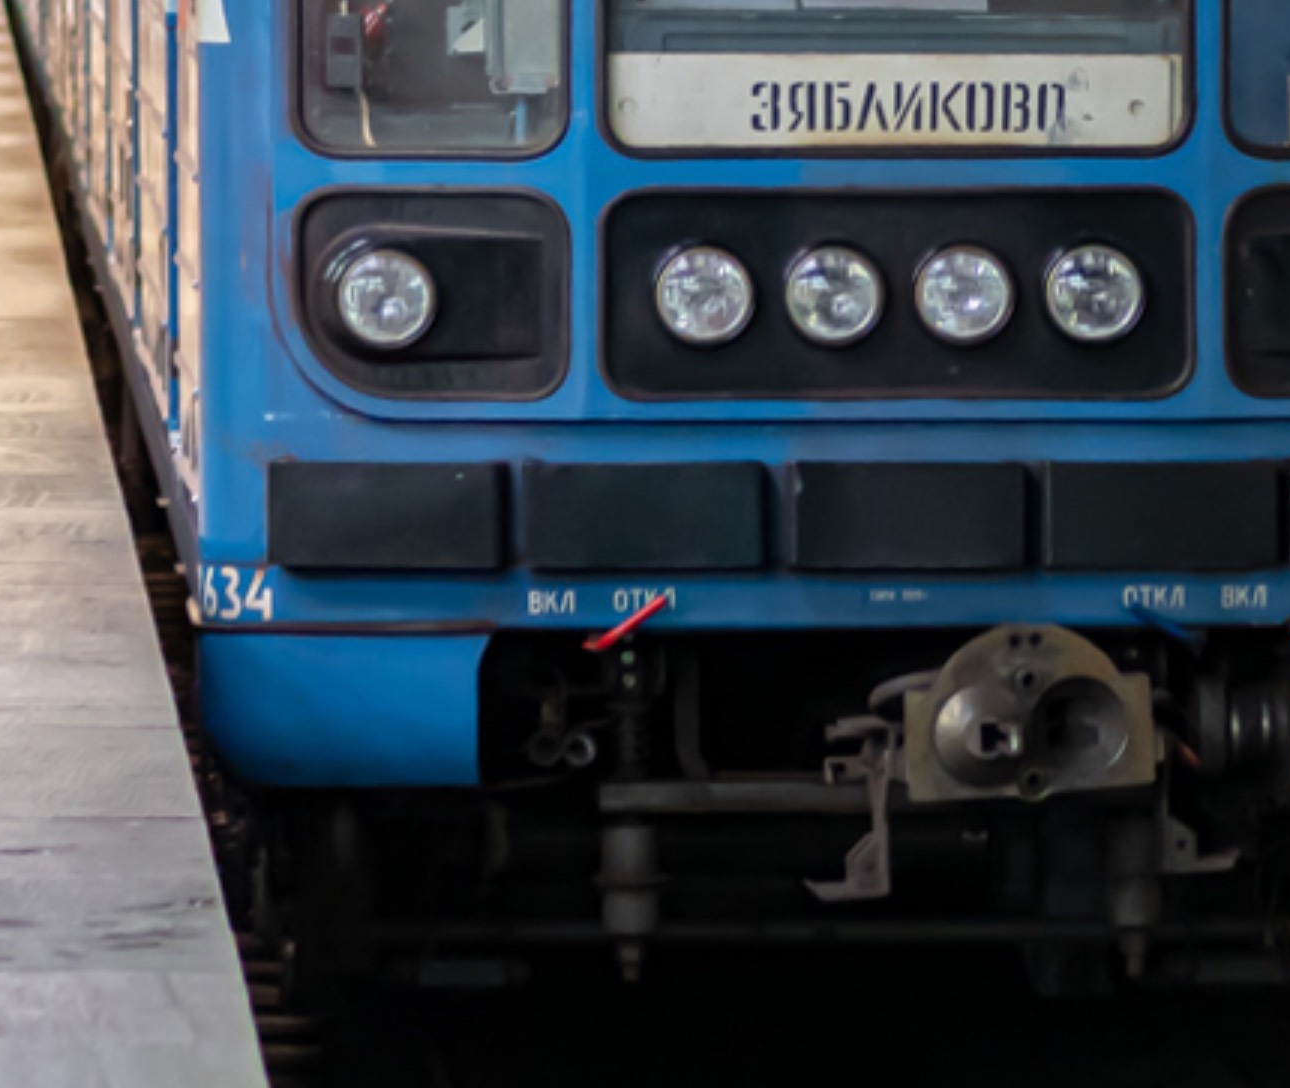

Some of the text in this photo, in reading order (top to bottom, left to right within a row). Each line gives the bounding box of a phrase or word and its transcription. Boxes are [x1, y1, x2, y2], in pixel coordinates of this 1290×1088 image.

[751, 81, 1067, 133] ЗЯБЛИКОВО
[528, 589, 576, 614] ВКЛ
[1221, 584, 1268, 610] ВКЛ
